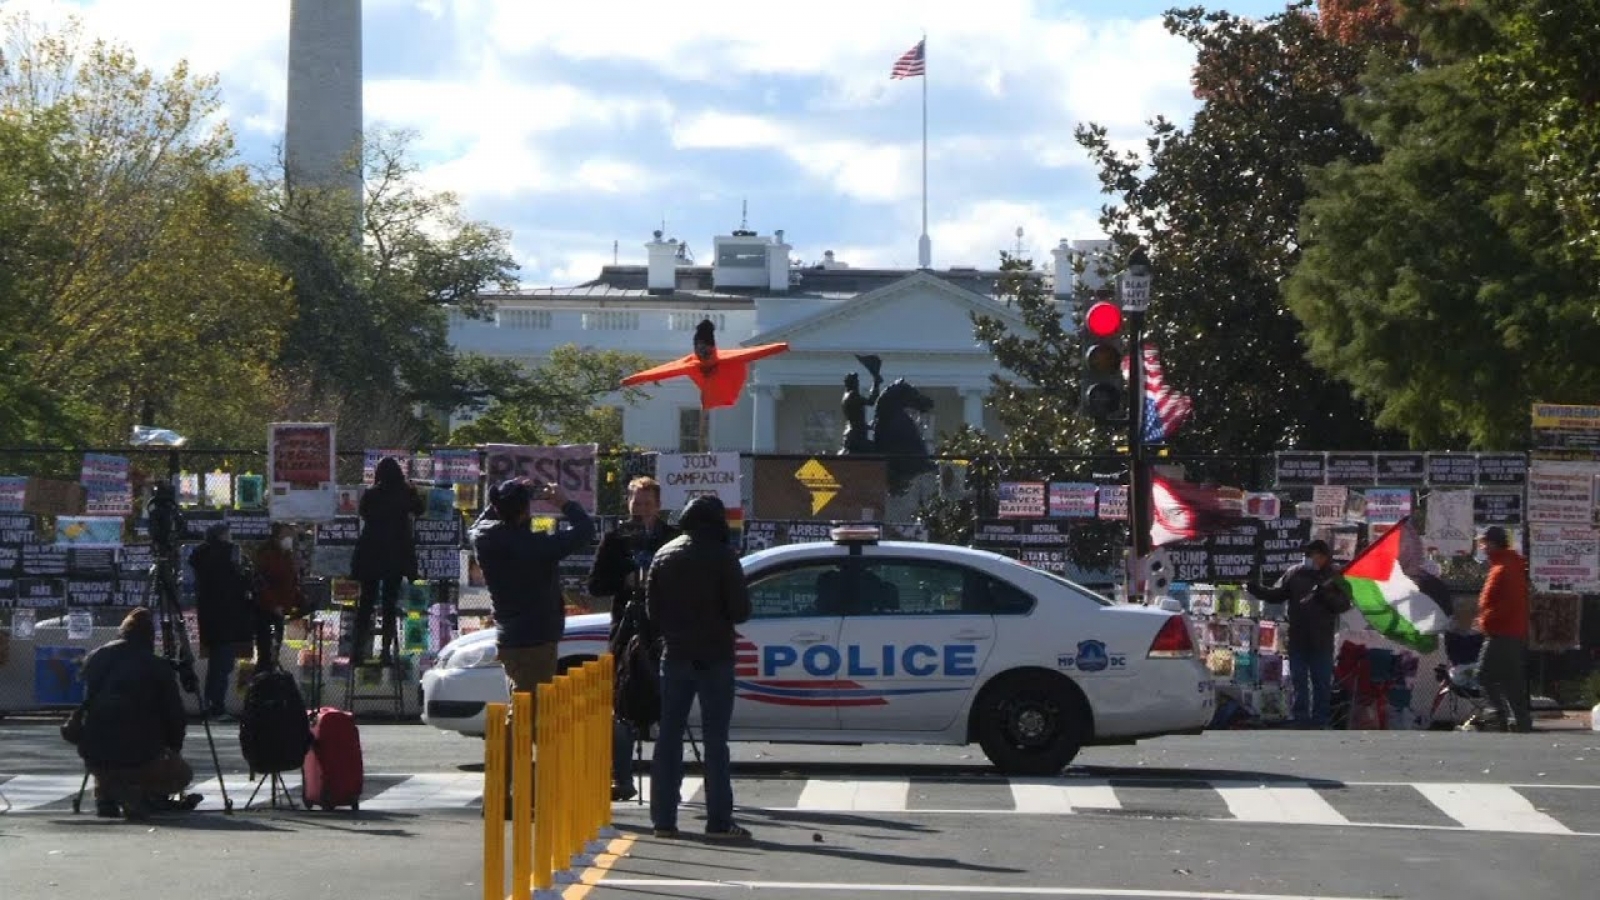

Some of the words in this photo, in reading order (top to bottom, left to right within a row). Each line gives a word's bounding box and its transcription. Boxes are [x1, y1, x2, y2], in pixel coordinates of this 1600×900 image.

[682, 455, 717, 469] JOIN
[491, 454, 595, 491] RESIST
[666, 471, 735, 486] CAMPAIGN
[1004, 486, 1041, 494] BLACK
[1105, 489, 1125, 497] BLA
[1315, 504, 1340, 518] QUIET
[415, 520, 458, 531] REMOVE
[1032, 524, 1059, 533] MORAL
[1264, 519, 1301, 529] TRUMP
[2, 530, 35, 543] UNFIT
[419, 531, 455, 542] TRUMP
[1022, 534, 1069, 543] EMERGENCY
[1277, 529, 1289, 539] IS
[1215, 535, 1231, 545] ARE
[1232, 535, 1255, 545] WEAK
[1264, 539, 1302, 550] GUILTY
[1022, 551, 1049, 561] STATE
[1166, 551, 1209, 565] TRUMP
[1213, 554, 1255, 566] REMOVE
[1178, 564, 1209, 579] SICK
[1214, 565, 1251, 576] TRUMP
[69, 582, 111, 592] REMOVE
[73, 593, 108, 603] TRUMP
[763, 644, 977, 677] POLICE
[1058, 656, 1075, 667] MP
[1110, 656, 1126, 667] DC
